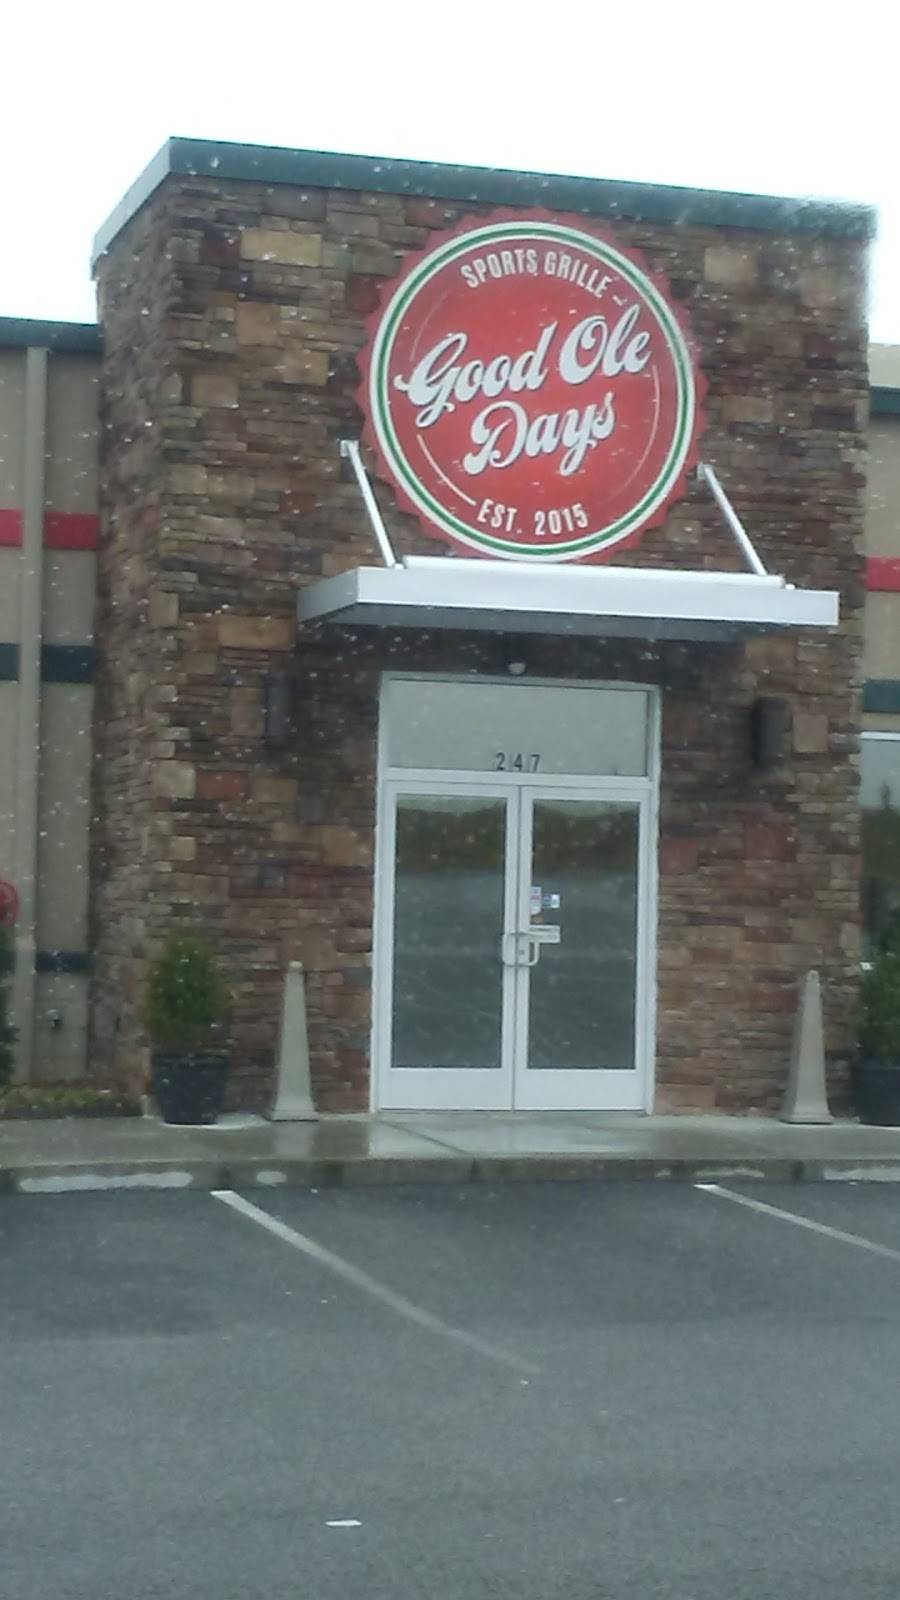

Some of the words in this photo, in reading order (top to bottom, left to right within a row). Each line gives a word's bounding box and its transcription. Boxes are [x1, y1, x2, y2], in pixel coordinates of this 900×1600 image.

[461, 249, 538, 288] SPORTS
[544, 251, 612, 298] GRILLE
[394, 321, 558, 428] Good
[559, 304, 652, 385] Ole
[463, 392, 616, 477] Days
[477, 499, 522, 534] EST.
[534, 503, 589, 535] 2015
[496, 752, 540, 772] 247
